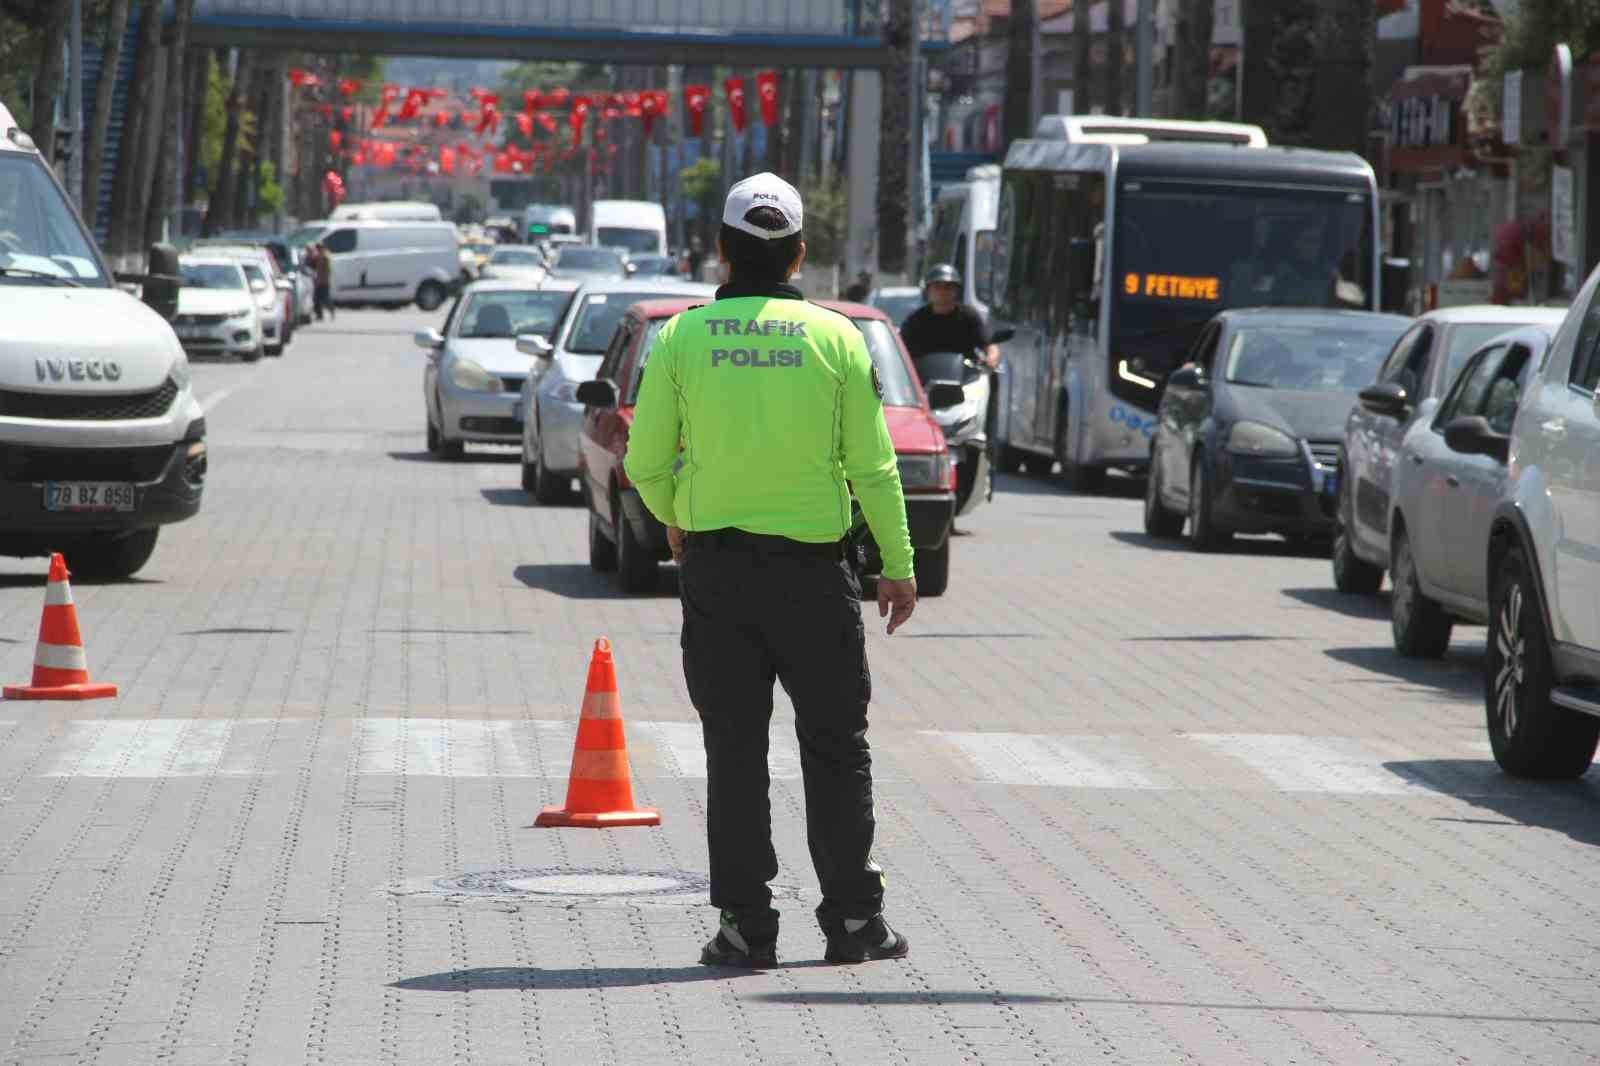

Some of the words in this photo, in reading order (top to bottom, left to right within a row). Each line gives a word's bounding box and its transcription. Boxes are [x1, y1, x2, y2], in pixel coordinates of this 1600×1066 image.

[1125, 273, 1139, 296] 9
[35, 359, 121, 382] IVECO
[54, 487, 73, 504] 78
[79, 487, 97, 505] BZ
